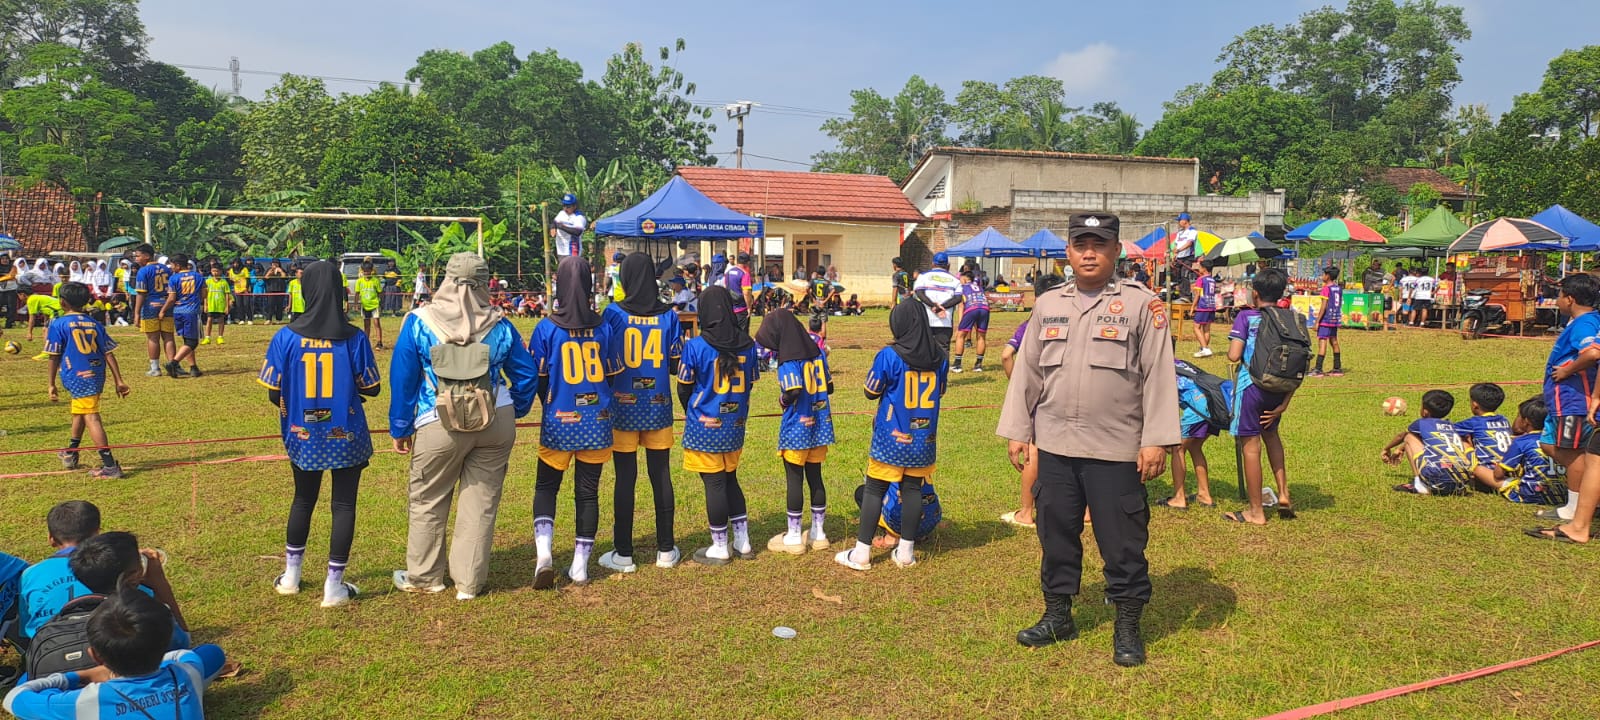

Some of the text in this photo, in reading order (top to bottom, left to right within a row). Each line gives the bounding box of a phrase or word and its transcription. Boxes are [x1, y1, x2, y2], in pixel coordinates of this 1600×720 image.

[816, 283, 824, 297] 6
[1096, 315, 1129, 325] POLRI
[72, 328, 98, 355] 07
[623, 327, 664, 369] 04
[301, 352, 334, 399] 11
[560, 341, 605, 385] 08
[803, 359, 828, 395] 03
[903, 370, 937, 409] 02
[1439, 432, 1464, 453] 14
[115, 701, 127, 716] SD
[129, 692, 161, 713] NEGERI
